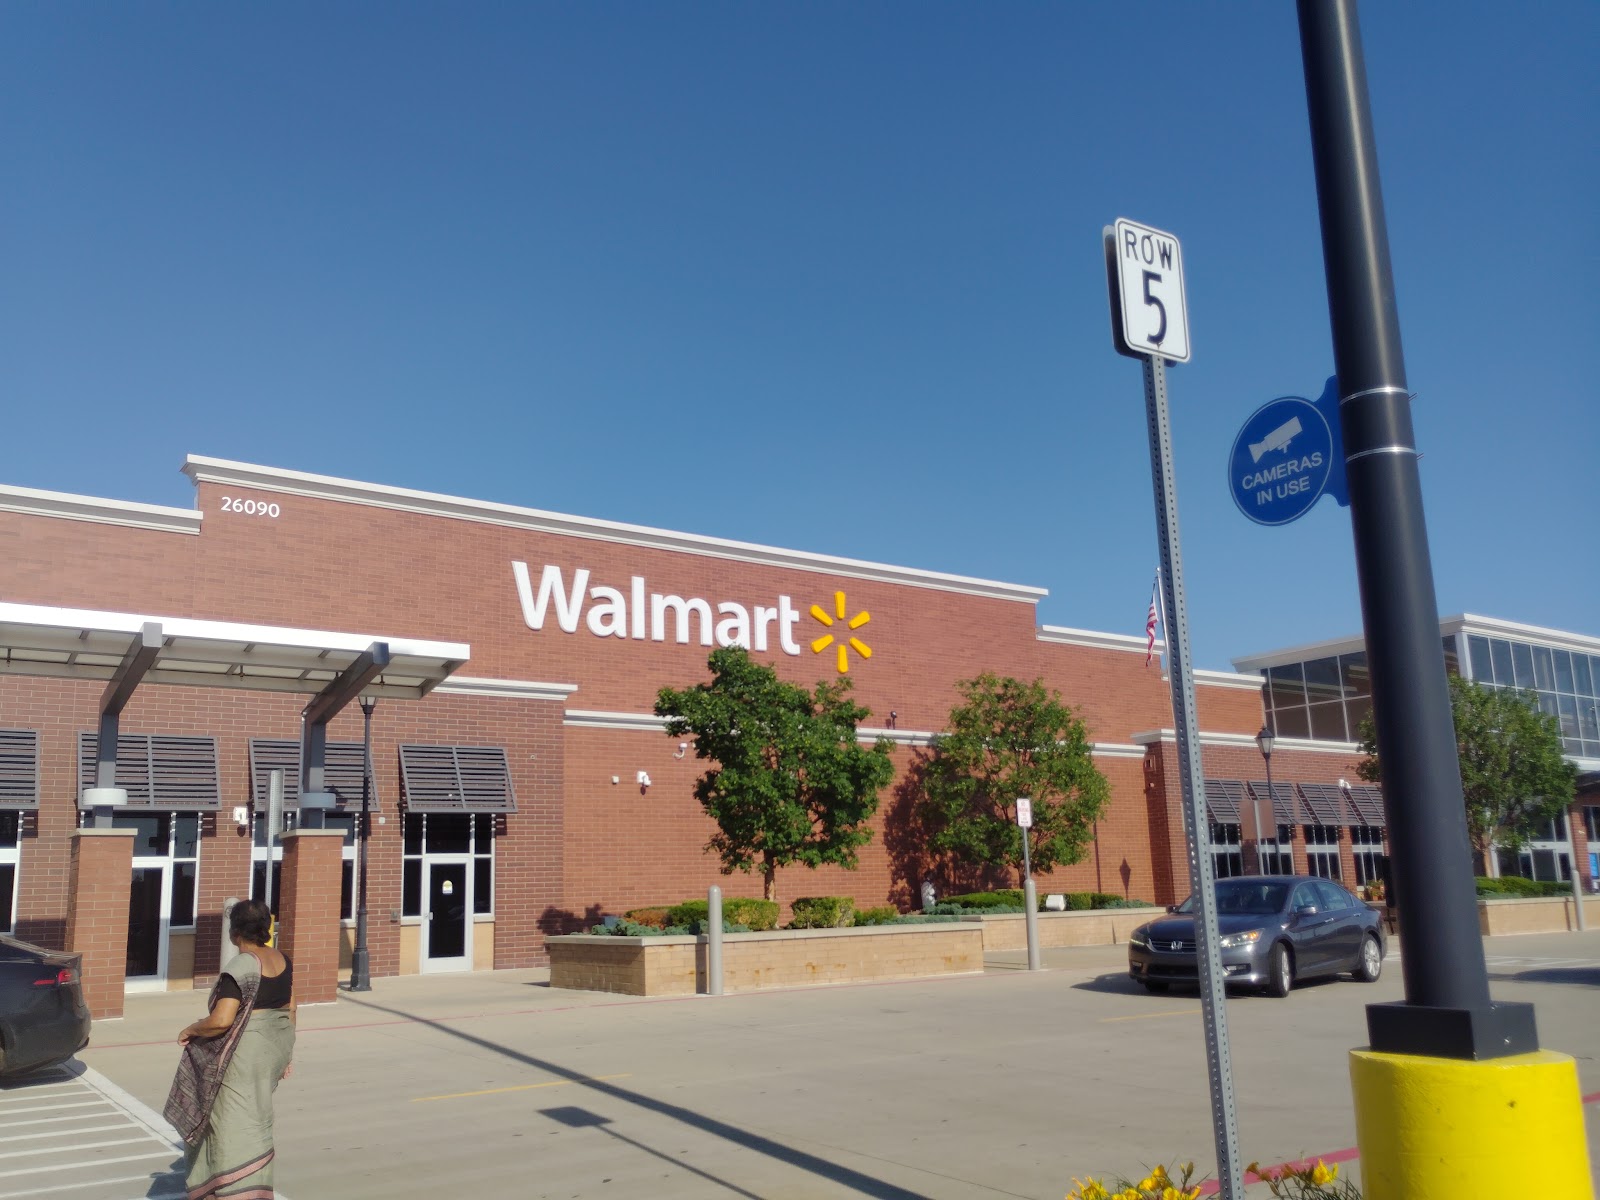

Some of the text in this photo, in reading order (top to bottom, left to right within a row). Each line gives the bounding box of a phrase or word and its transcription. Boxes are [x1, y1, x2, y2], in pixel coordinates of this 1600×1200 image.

[1124, 229, 1173, 271] ROW
[1141, 268, 1168, 344] 5
[1242, 451, 1323, 490] CAMERAS
[1257, 476, 1310, 505] IN USE
[220, 496, 280, 518] 26090
[511, 560, 801, 656] Walmart
